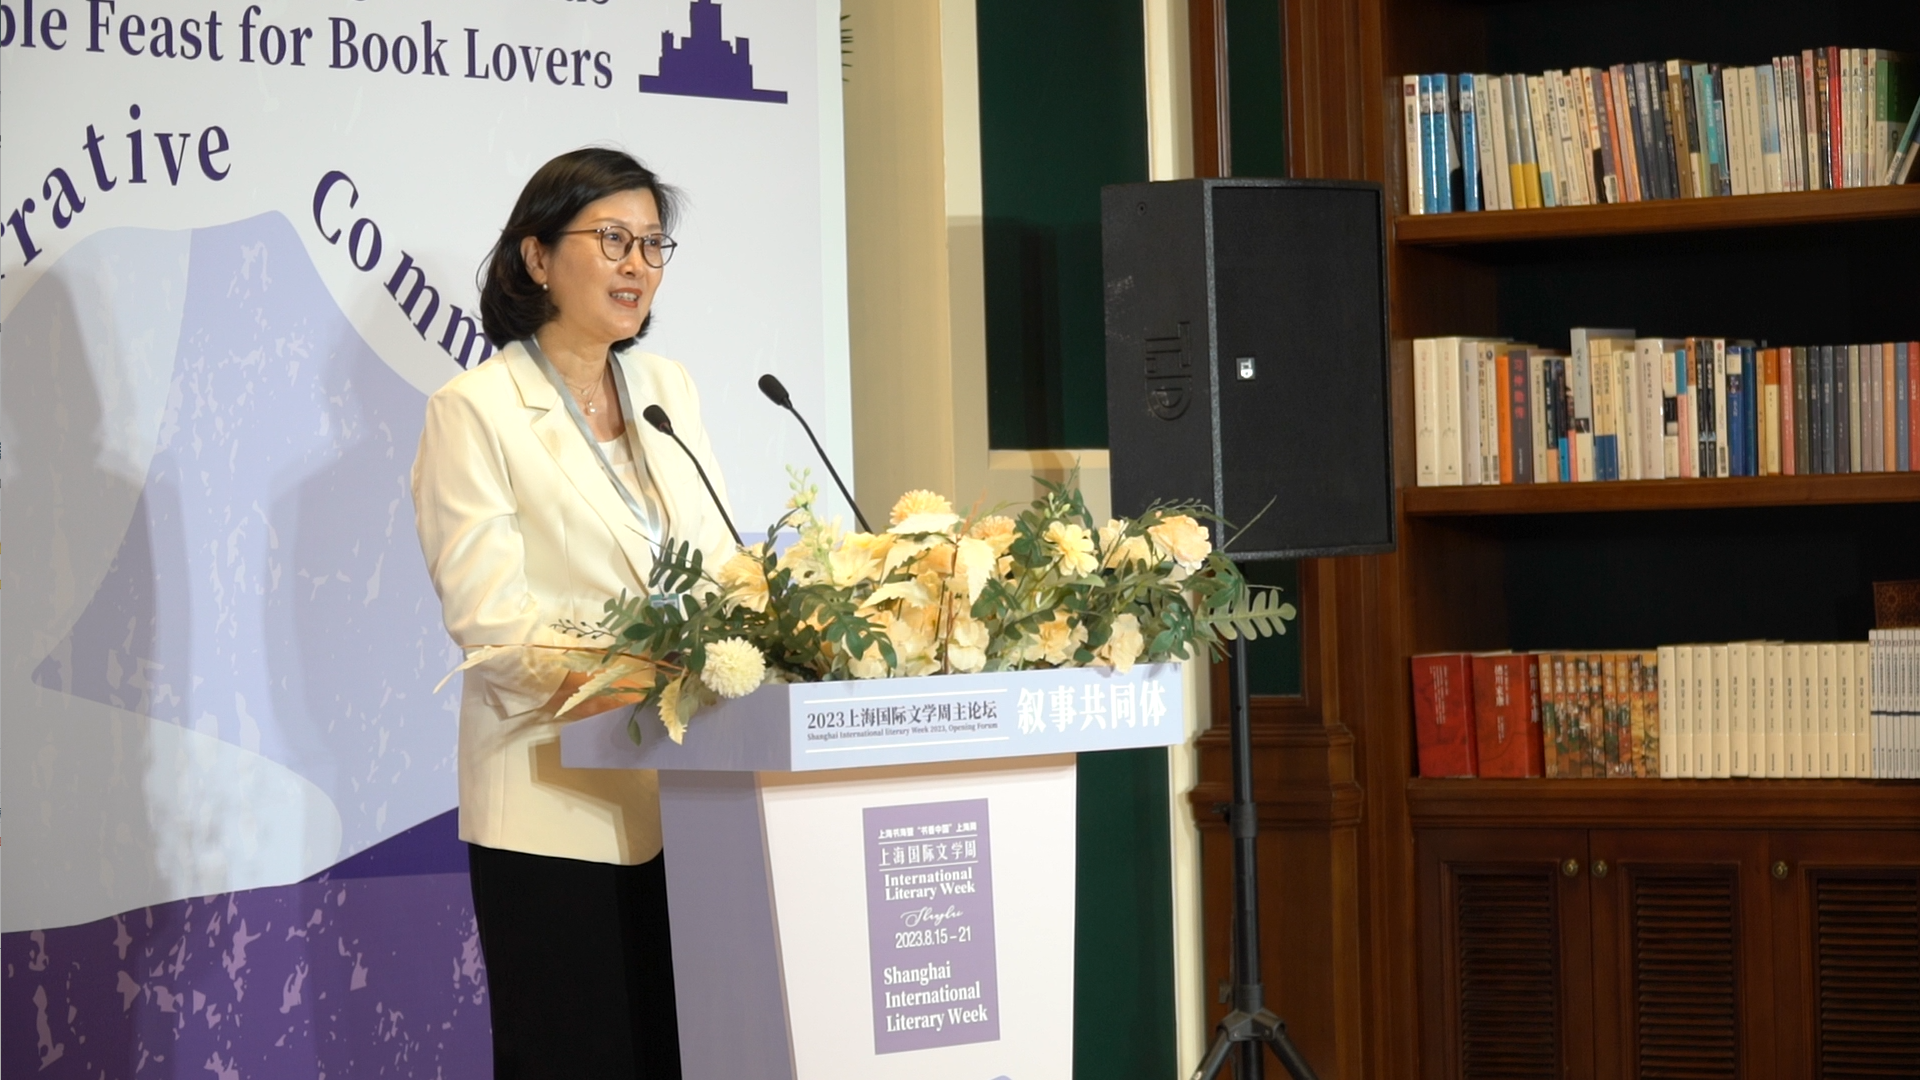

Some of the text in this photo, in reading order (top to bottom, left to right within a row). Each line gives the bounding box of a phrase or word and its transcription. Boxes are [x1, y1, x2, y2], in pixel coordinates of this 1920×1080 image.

[86, 0, 224, 62] Feast
[239, 4, 313, 66] for
[328, 16, 449, 77] Book
[463, 27, 613, 89] Lovers
[0, 103, 231, 279] rative
[1016, 680, 1167, 735] 叙事共同体
[807, 731, 838, 742] Shanghai
[840, 726, 884, 739] International
[911, 726, 928, 735] Week
[948, 723, 976, 733] Opening
[977, 722, 998, 730] Forum
[879, 840, 977, 866] 上海国际文学周
[885, 867, 972, 887] International
[885, 880, 976, 901] Literary Week
[884, 961, 951, 986] Shanghai
[885, 980, 980, 1009] International
[886, 1004, 988, 1032] Literary Week
